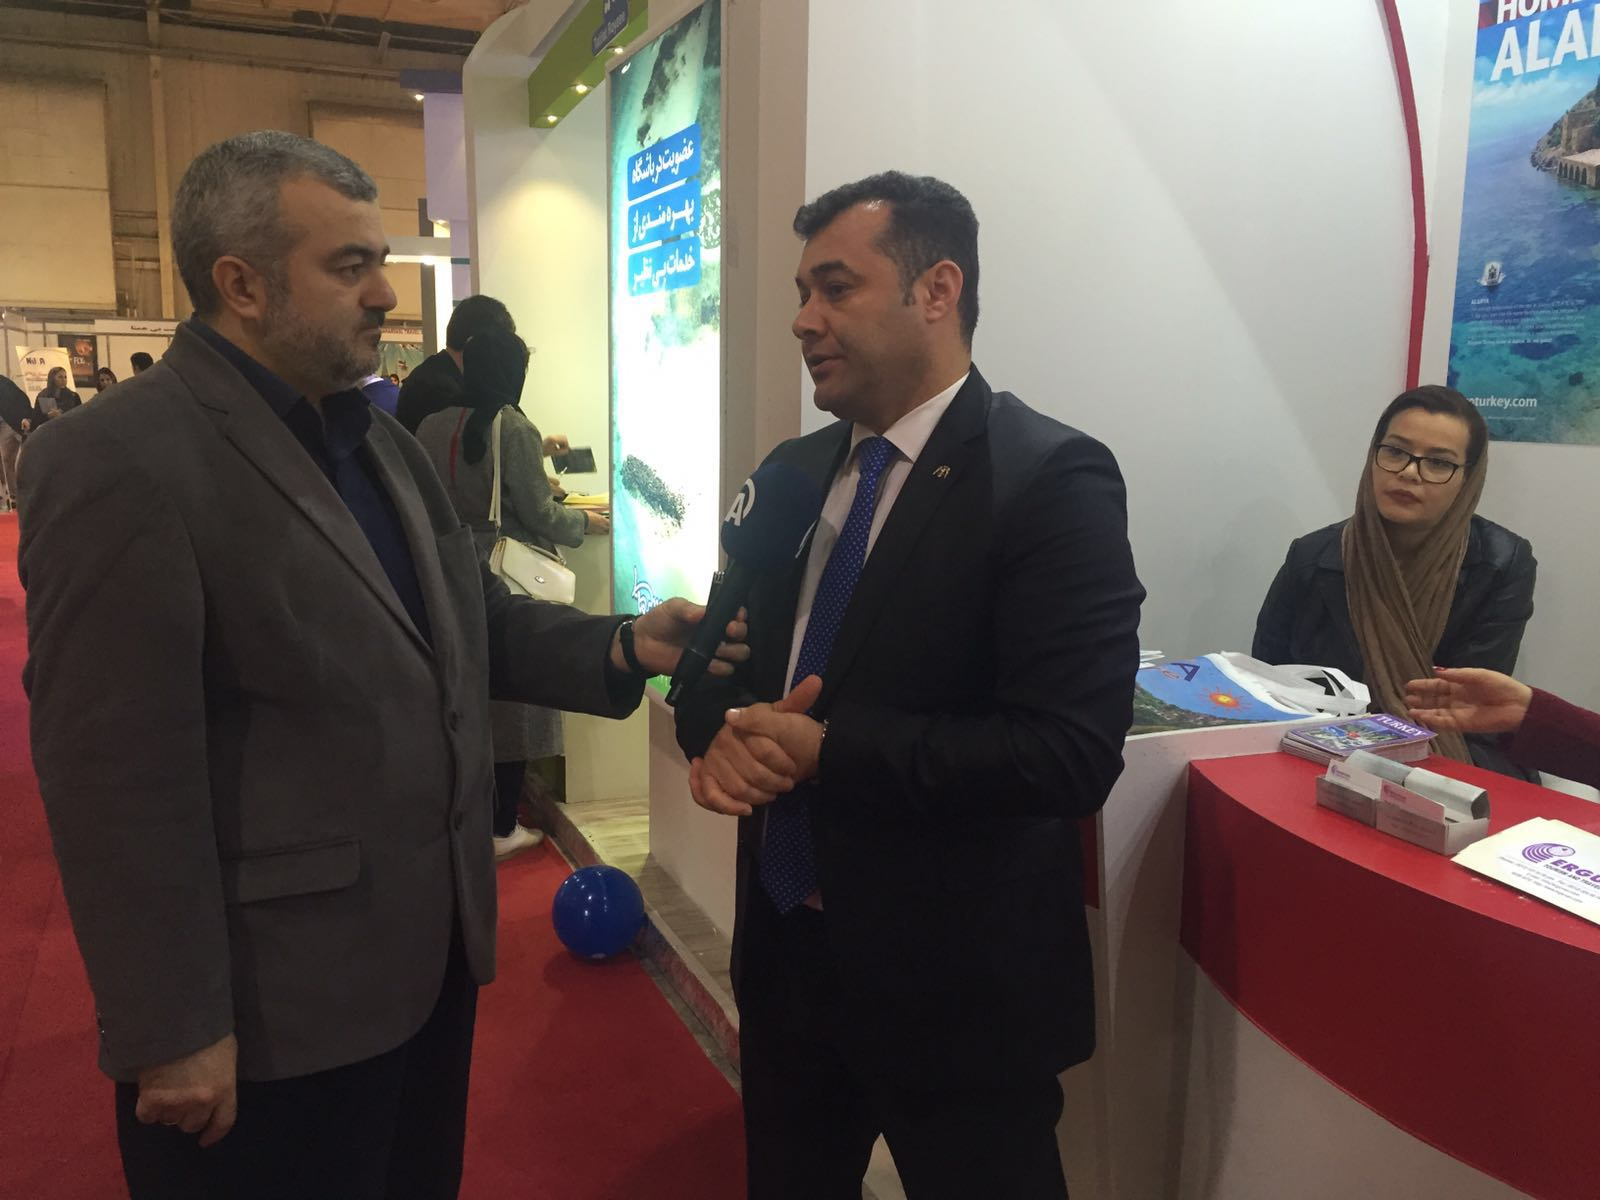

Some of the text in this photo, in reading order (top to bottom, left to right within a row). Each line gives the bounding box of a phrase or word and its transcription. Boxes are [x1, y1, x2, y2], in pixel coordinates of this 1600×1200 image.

[1496, 0, 1583, 25] HO
[1466, 394, 1538, 409] nturkey.com
[1376, 715, 1429, 737] TURKEY
